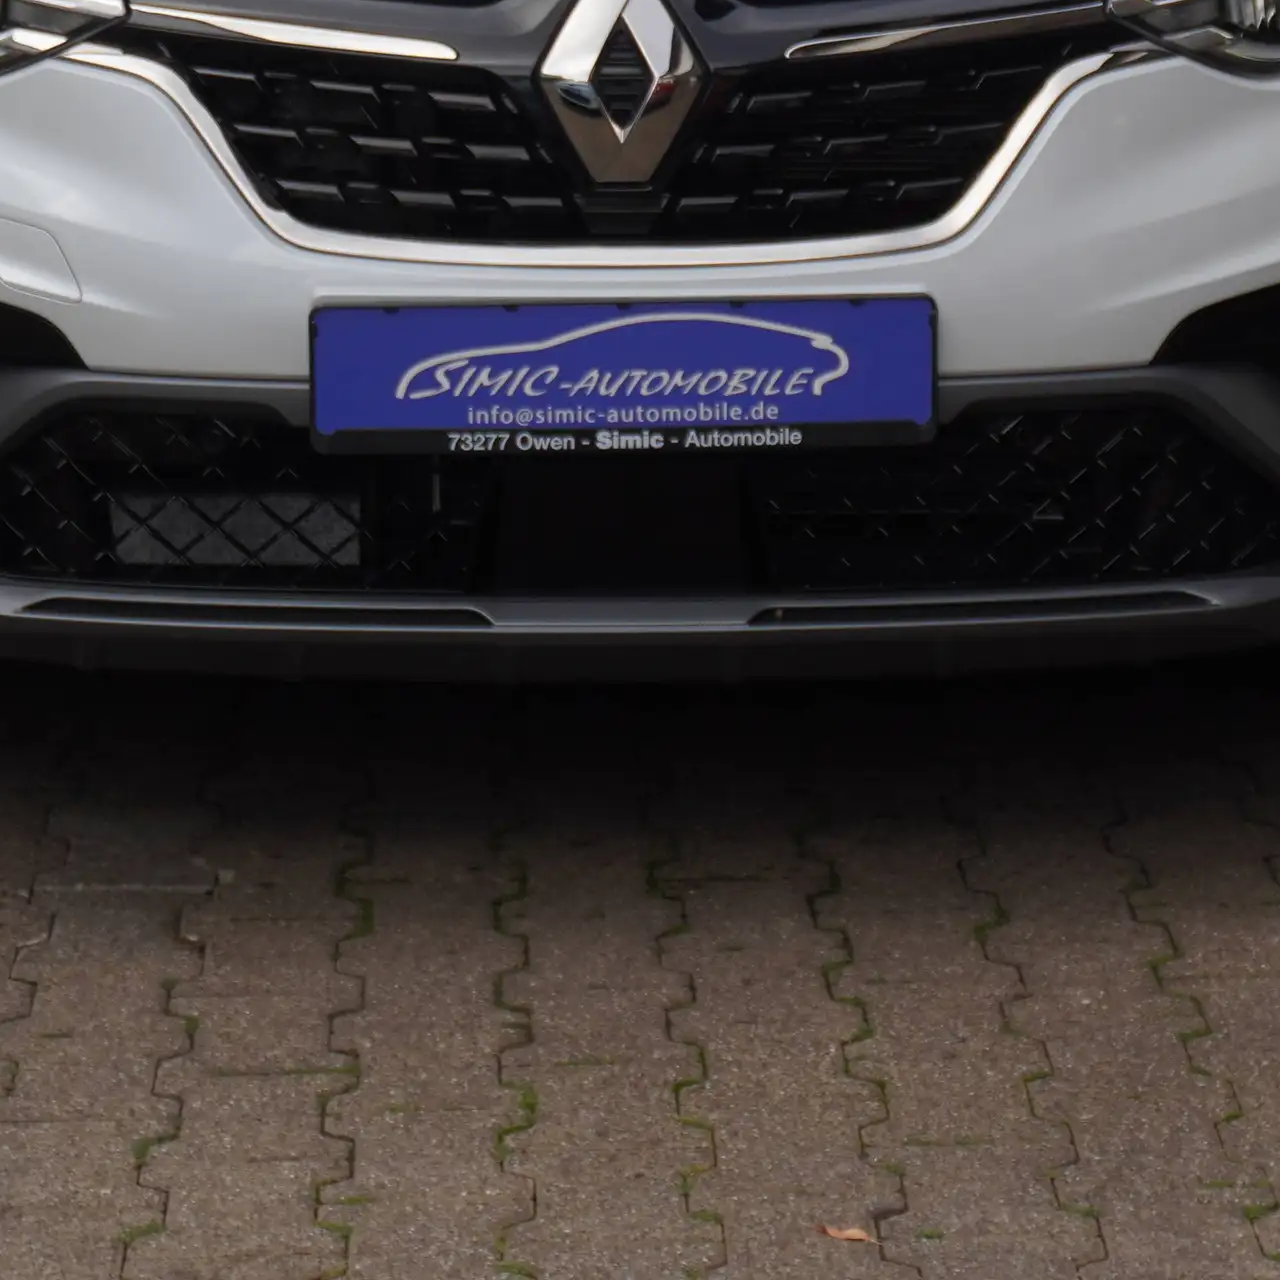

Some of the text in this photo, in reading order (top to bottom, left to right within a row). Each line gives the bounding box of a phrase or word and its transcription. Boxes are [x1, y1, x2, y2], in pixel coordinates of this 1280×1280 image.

[468, 401, 779, 426] info@simic-automobile.de
[448, 431, 511, 451] 73277
[515, 431, 576, 451] Owen
[595, 429, 664, 450] Simic
[684, 428, 803, 448] Automobile
